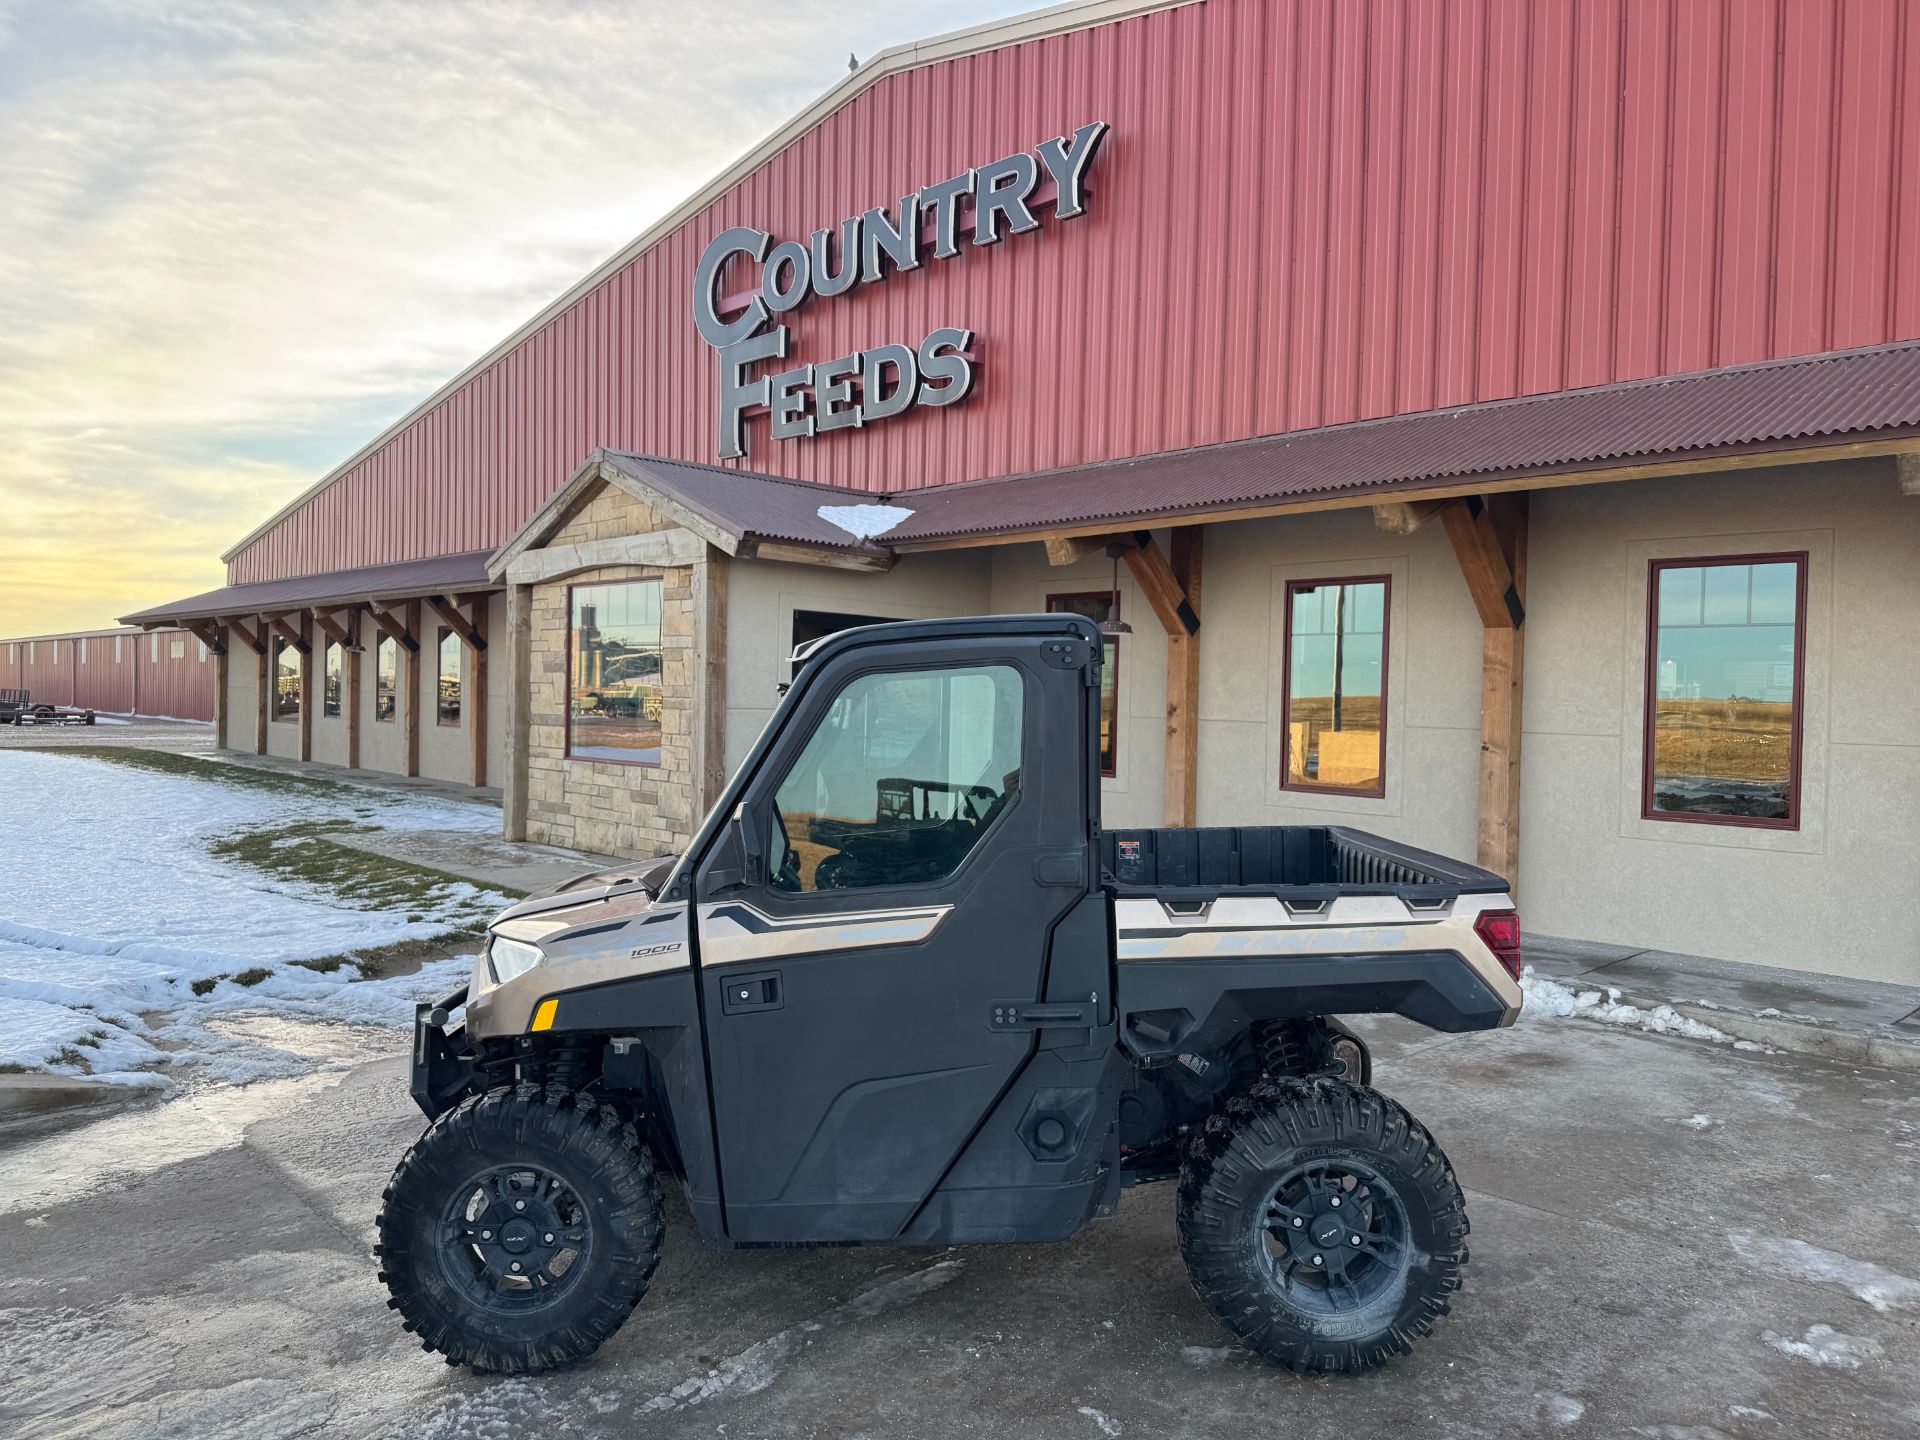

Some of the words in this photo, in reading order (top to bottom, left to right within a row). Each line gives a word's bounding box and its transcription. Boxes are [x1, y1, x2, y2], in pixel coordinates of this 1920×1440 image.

[693, 121, 1110, 349] COUNTRY
[716, 324, 978, 460] FEEDS
[631, 942, 682, 957] 1000
[1214, 929, 1407, 954] RANGER
